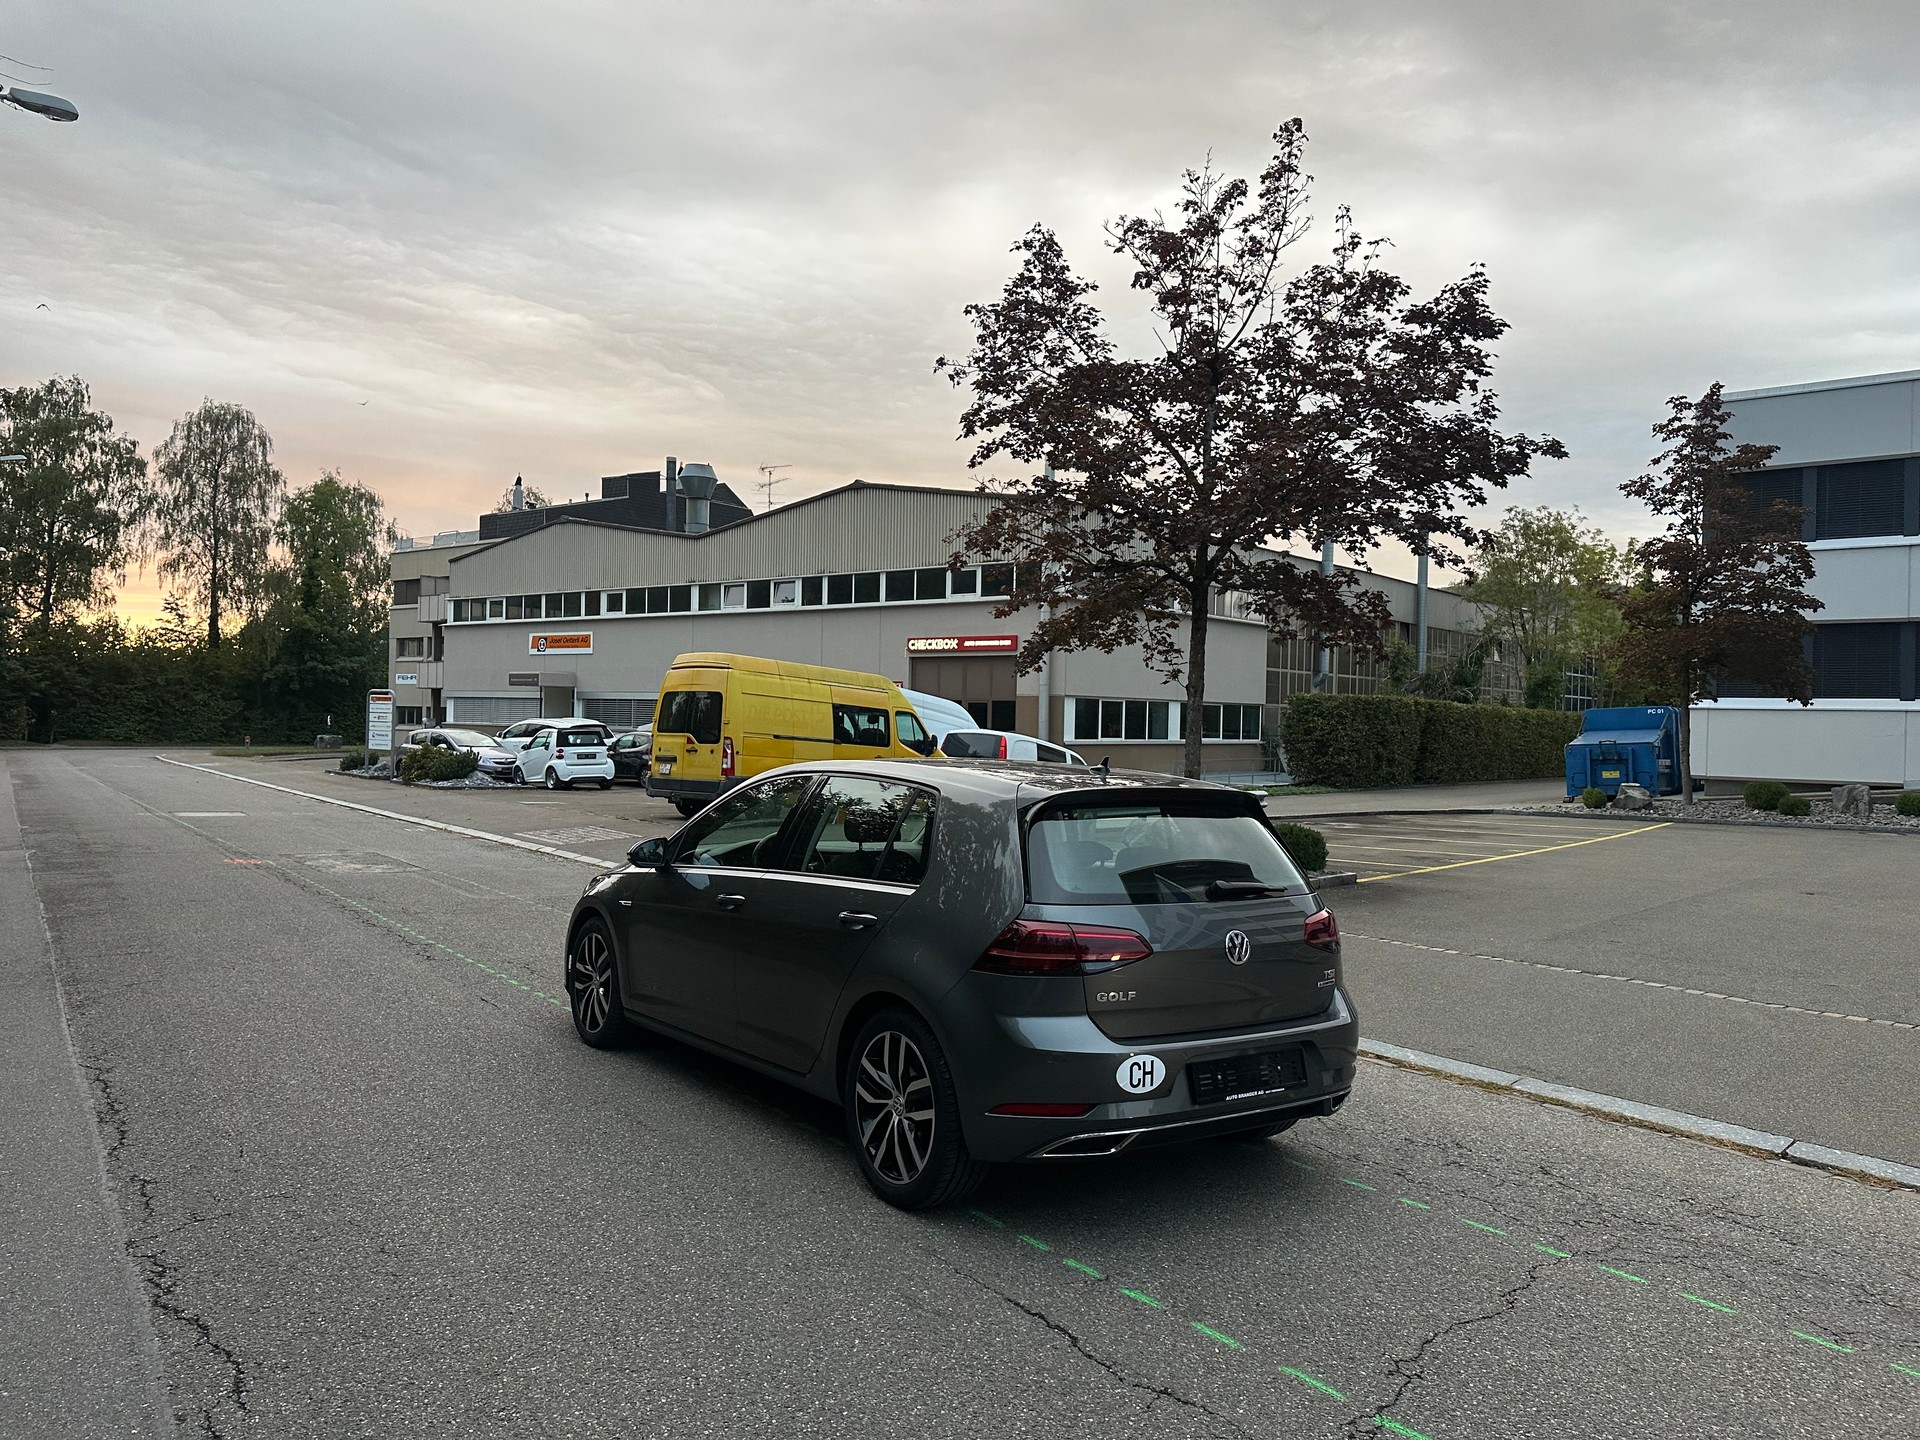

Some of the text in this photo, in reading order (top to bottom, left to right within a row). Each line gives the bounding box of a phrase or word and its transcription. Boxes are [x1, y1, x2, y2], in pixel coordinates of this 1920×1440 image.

[908, 638, 958, 650] CHECKBOX
[1323, 969, 1336, 979] TSI
[1096, 991, 1136, 1002] GOLF
[1129, 1060, 1154, 1088] CH
